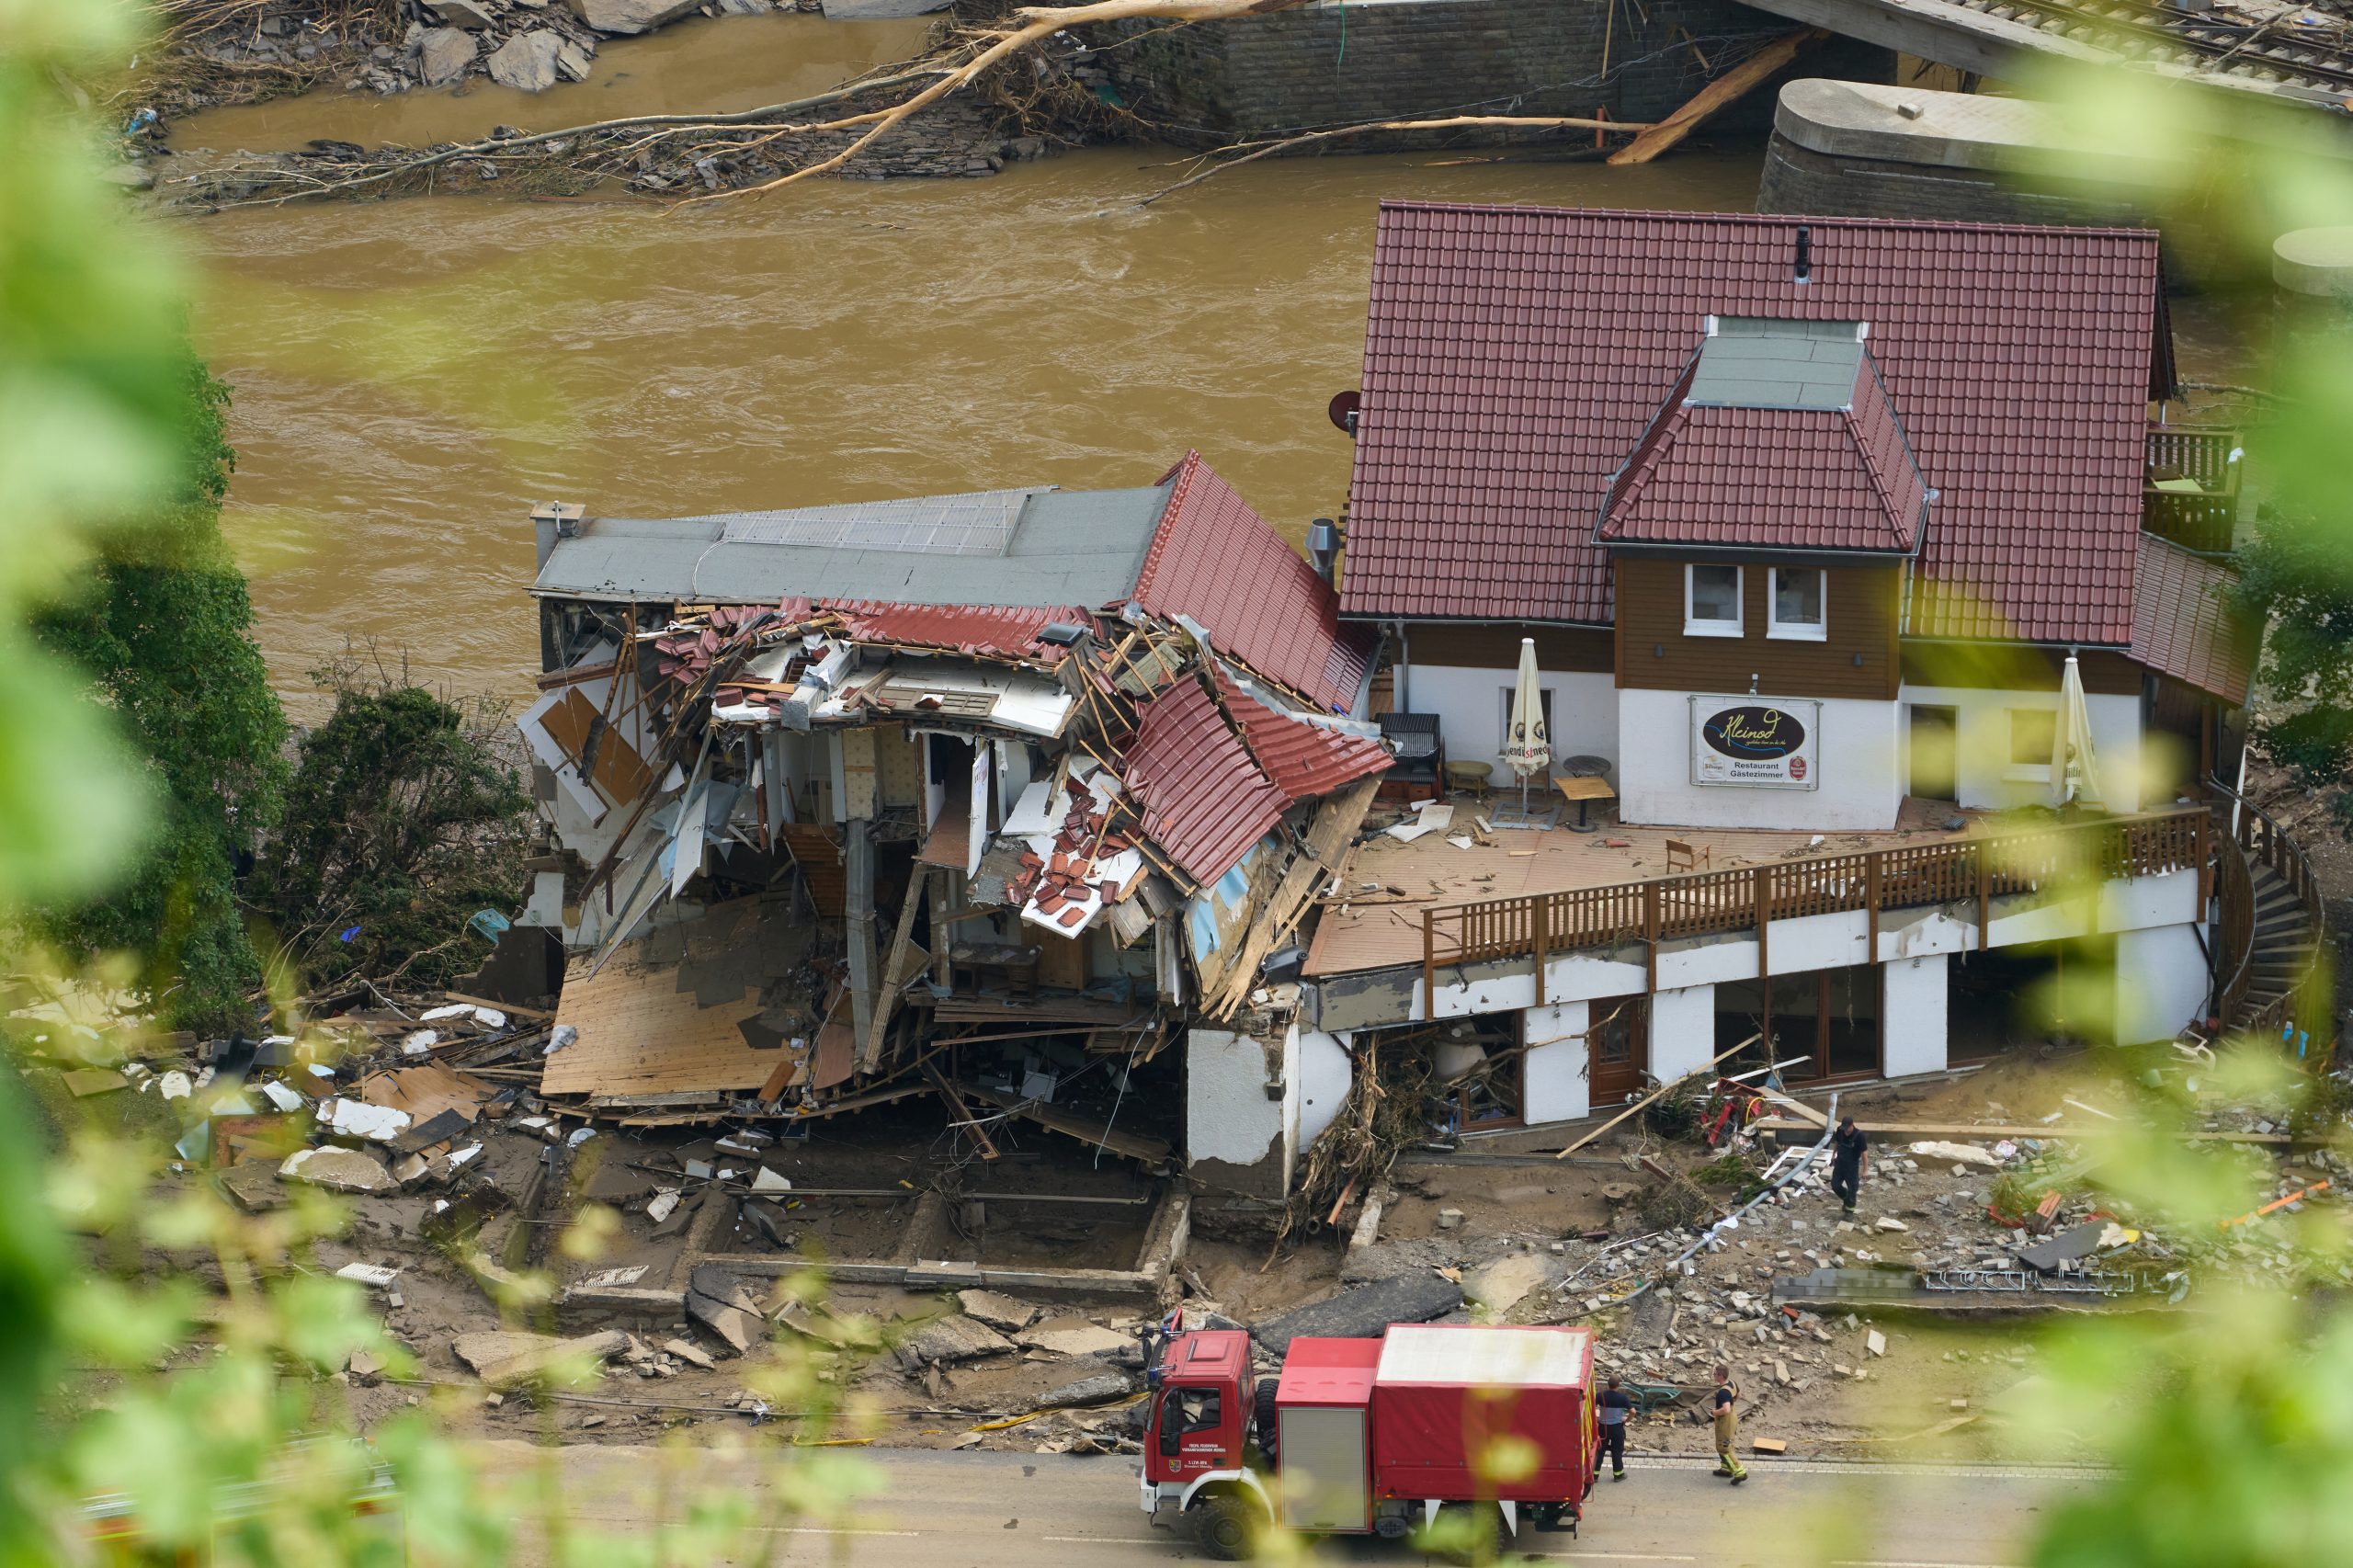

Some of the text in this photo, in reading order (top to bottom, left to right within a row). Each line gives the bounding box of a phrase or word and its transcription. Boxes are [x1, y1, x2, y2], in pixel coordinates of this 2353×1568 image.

[1720, 709, 1781, 747] Kleinod
[1734, 761, 1779, 769] Restaurant
[1730, 770, 1783, 778] Gästezimmer
